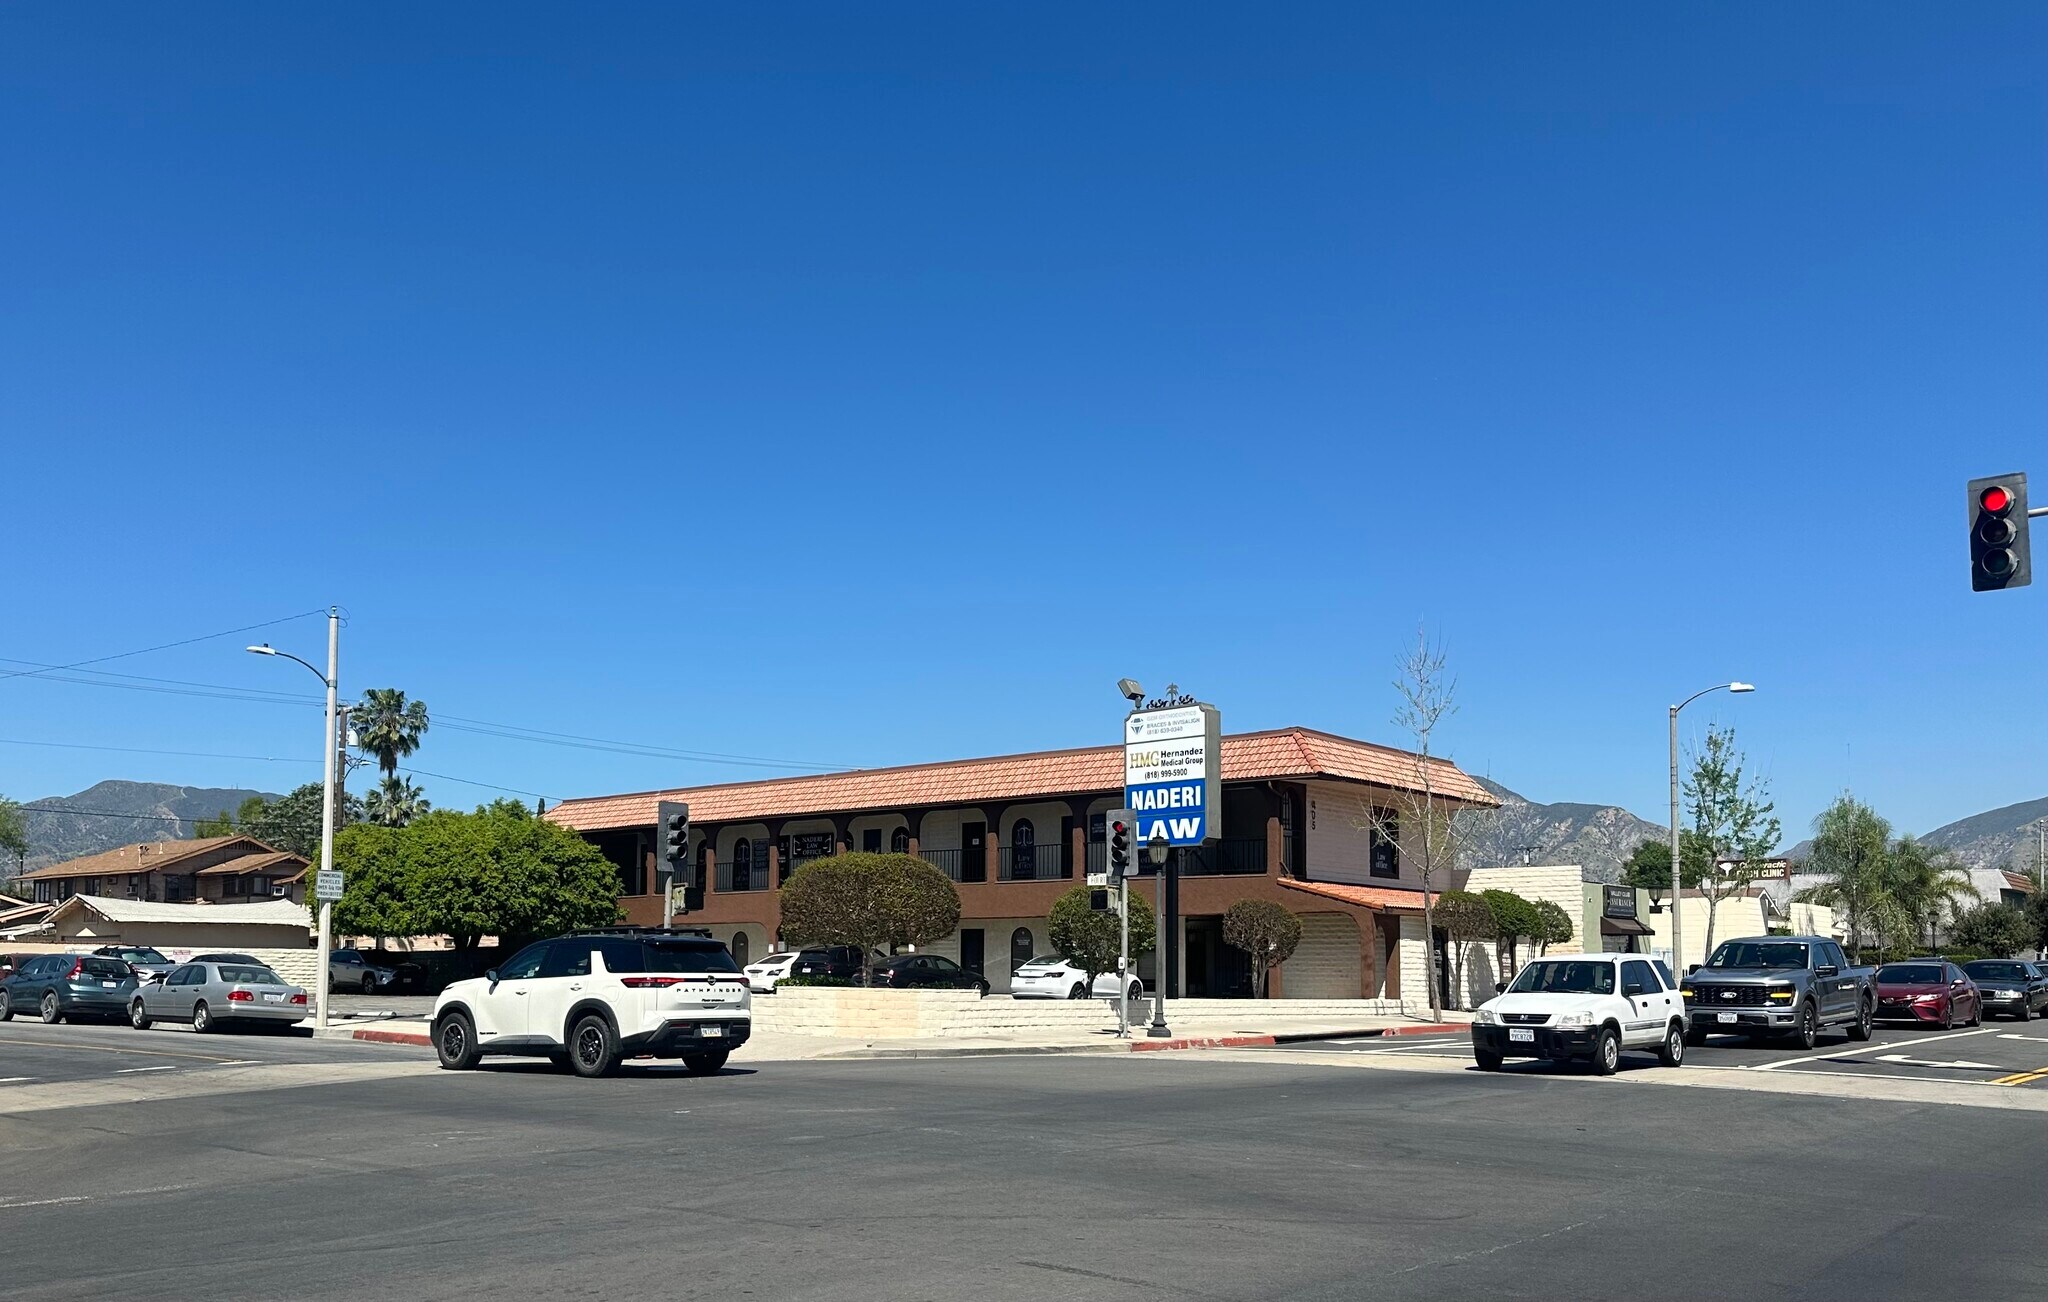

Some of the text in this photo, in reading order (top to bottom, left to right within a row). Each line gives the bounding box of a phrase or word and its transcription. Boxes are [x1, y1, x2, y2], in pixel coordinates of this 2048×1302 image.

[1158, 710, 1197, 720] ORTHODONTICS
[1146, 721, 1167, 729] BRACES
[1172, 717, 1201, 726] INVISALIGN
[1160, 747, 1204, 759] Hernandez
[1129, 750, 1160, 769] HMG
[1160, 756, 1204, 767] Medical Group
[1144, 767, 1188, 781] (818) 999-5900
[1131, 785, 1201, 811] NADERI
[1136, 817, 1201, 841] LAW
[1761, 869, 1785, 878] CLINIC
